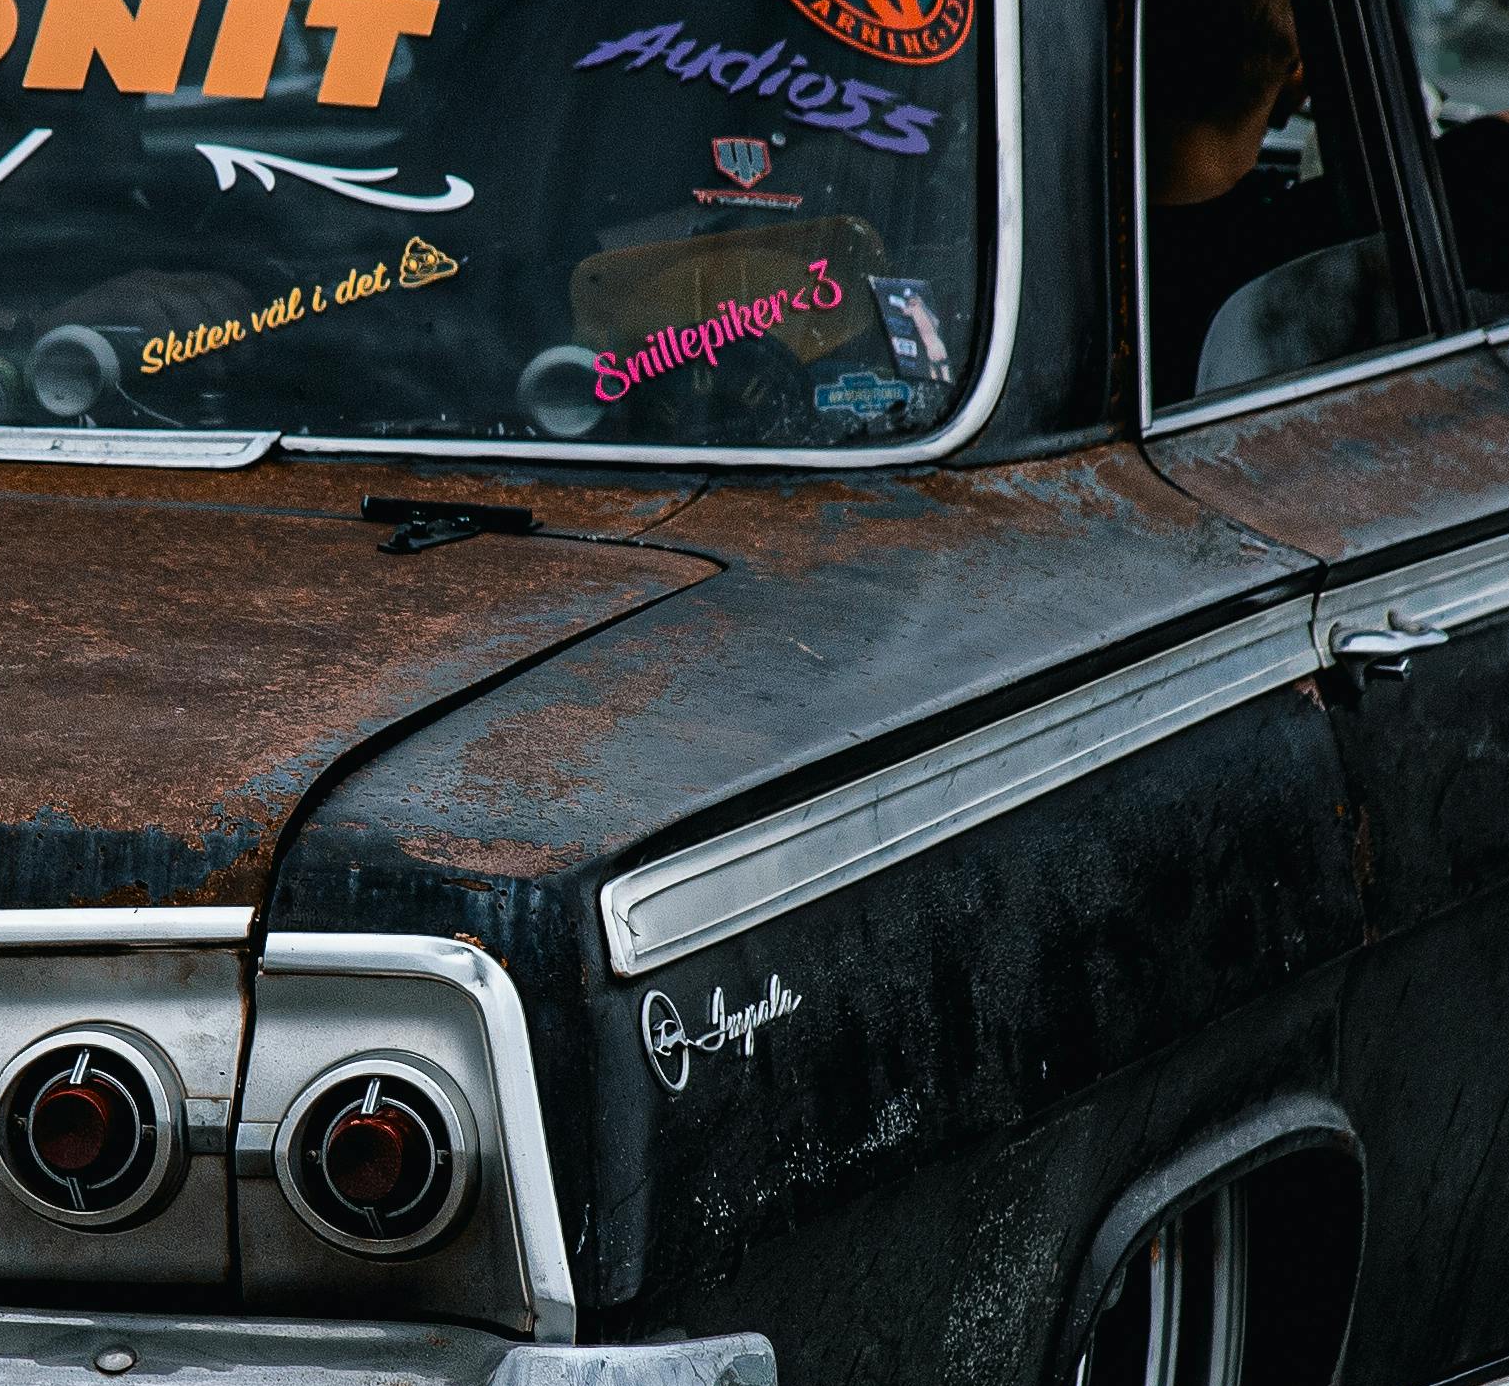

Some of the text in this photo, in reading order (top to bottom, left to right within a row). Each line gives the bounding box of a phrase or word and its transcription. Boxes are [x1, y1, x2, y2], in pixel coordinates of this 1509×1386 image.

[251, 287, 305, 333] väl
[312, 285, 327, 313] i
[334, 262, 391, 305] det
[695, 974, 802, 1057] Impala
